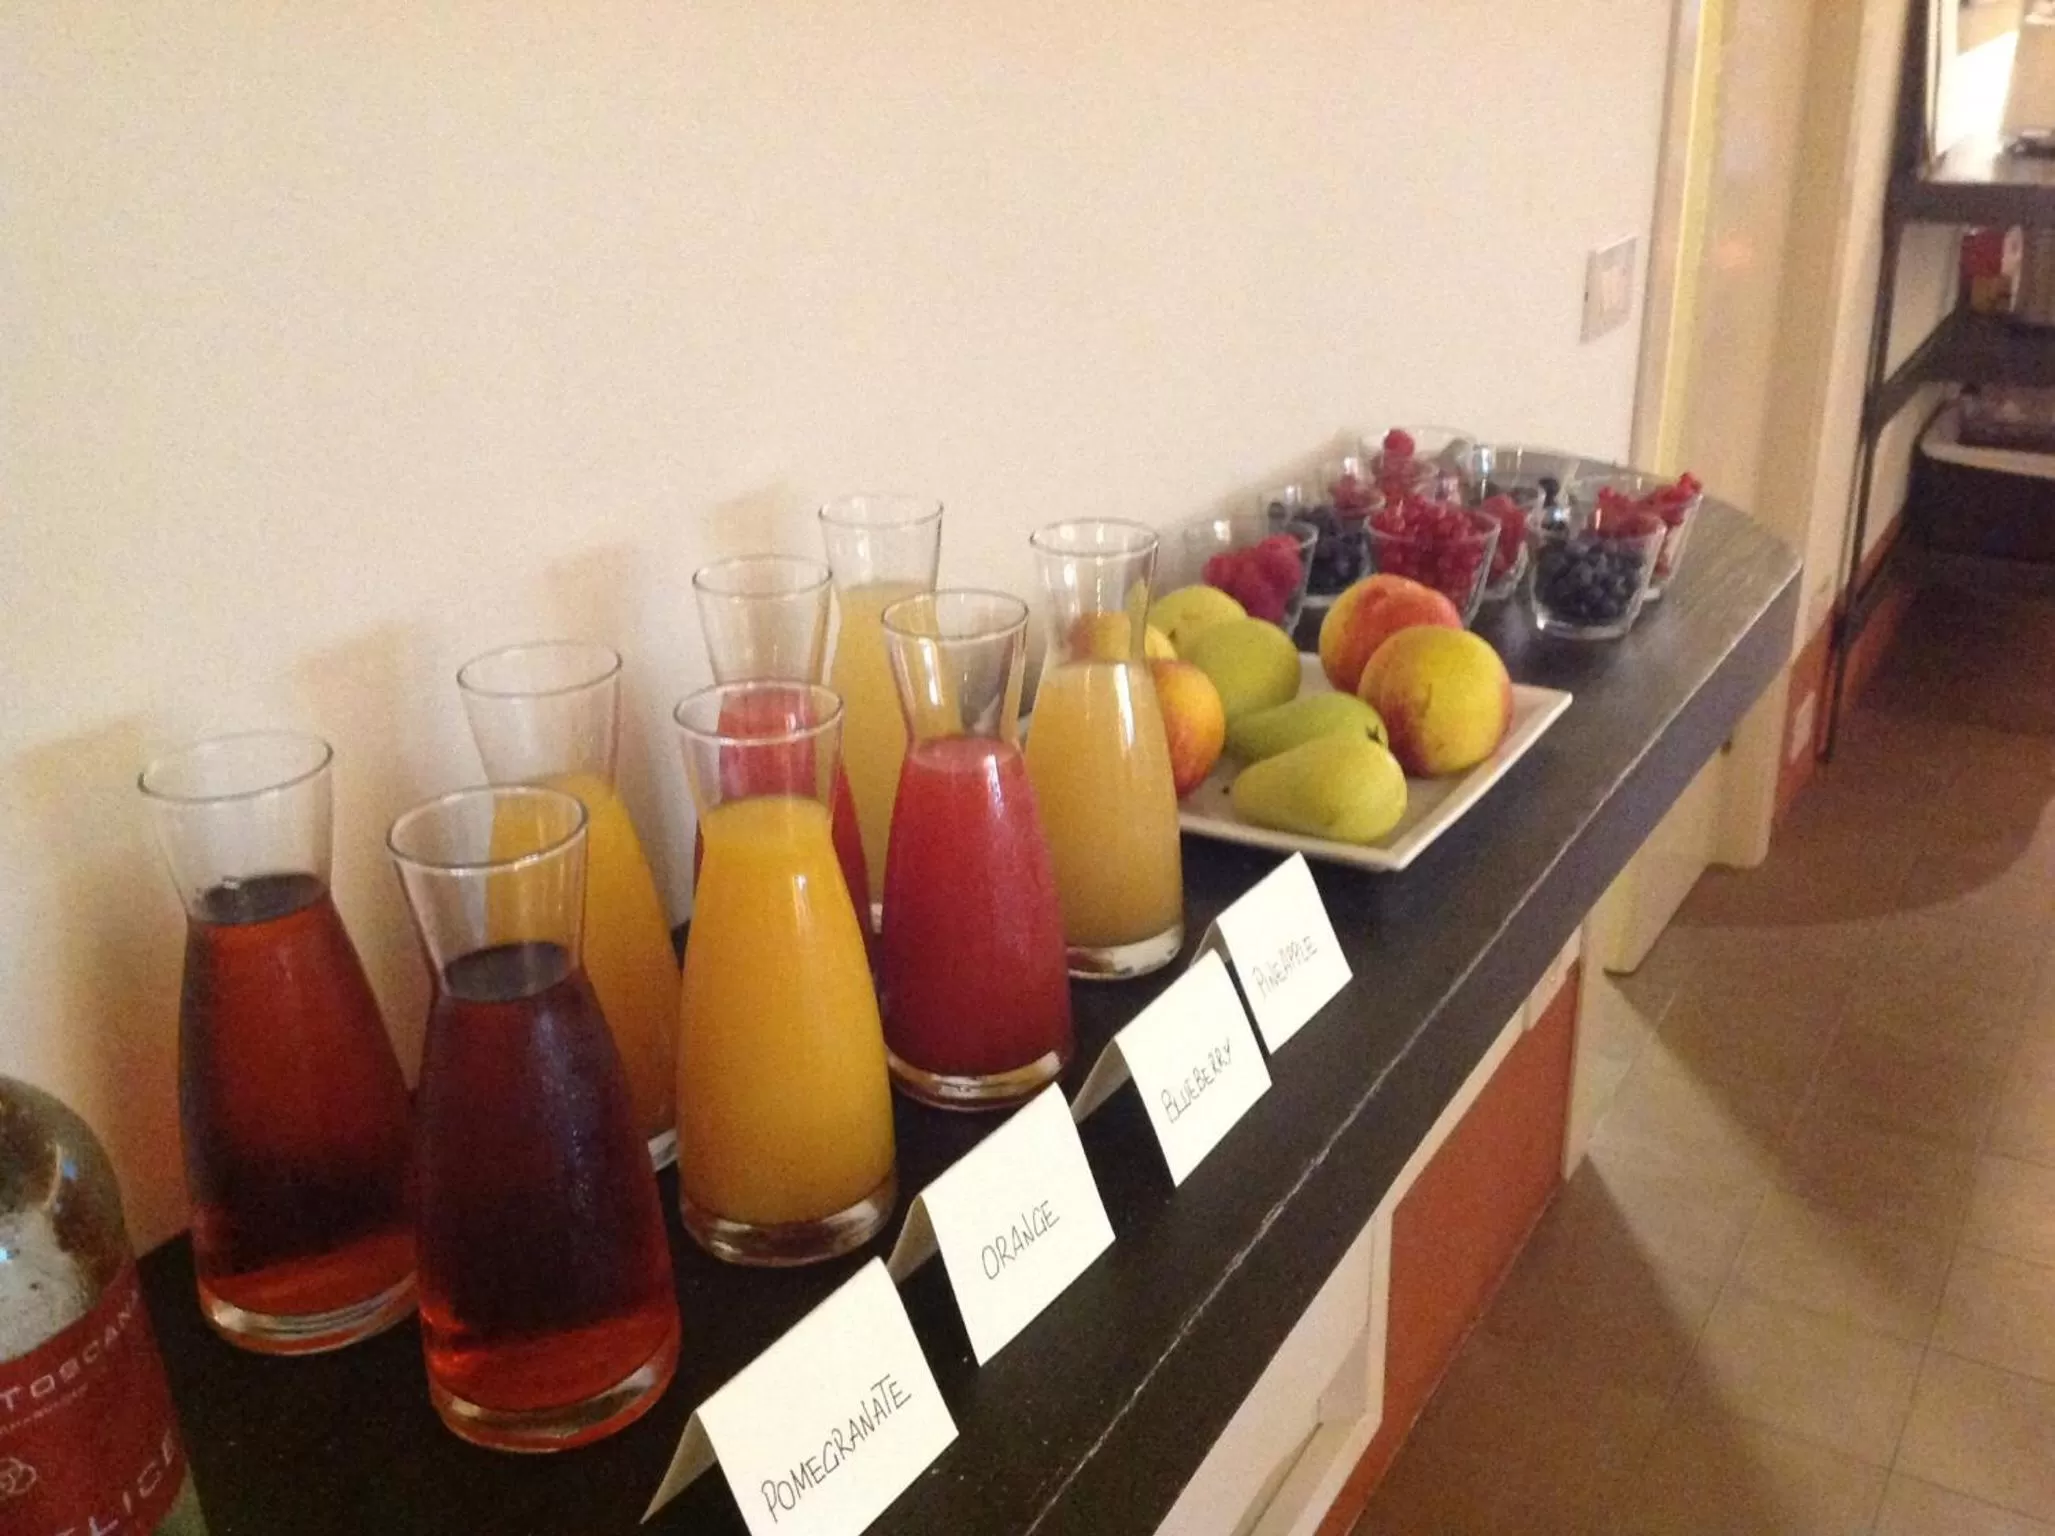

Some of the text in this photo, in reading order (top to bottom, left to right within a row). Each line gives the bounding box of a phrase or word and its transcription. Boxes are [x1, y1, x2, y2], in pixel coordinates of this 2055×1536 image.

[1160, 1037, 1232, 1124] BLUEBERRY
[981, 1199, 1061, 1281] ORANGE
[760, 1374, 912, 1524] POMEGRANATE
